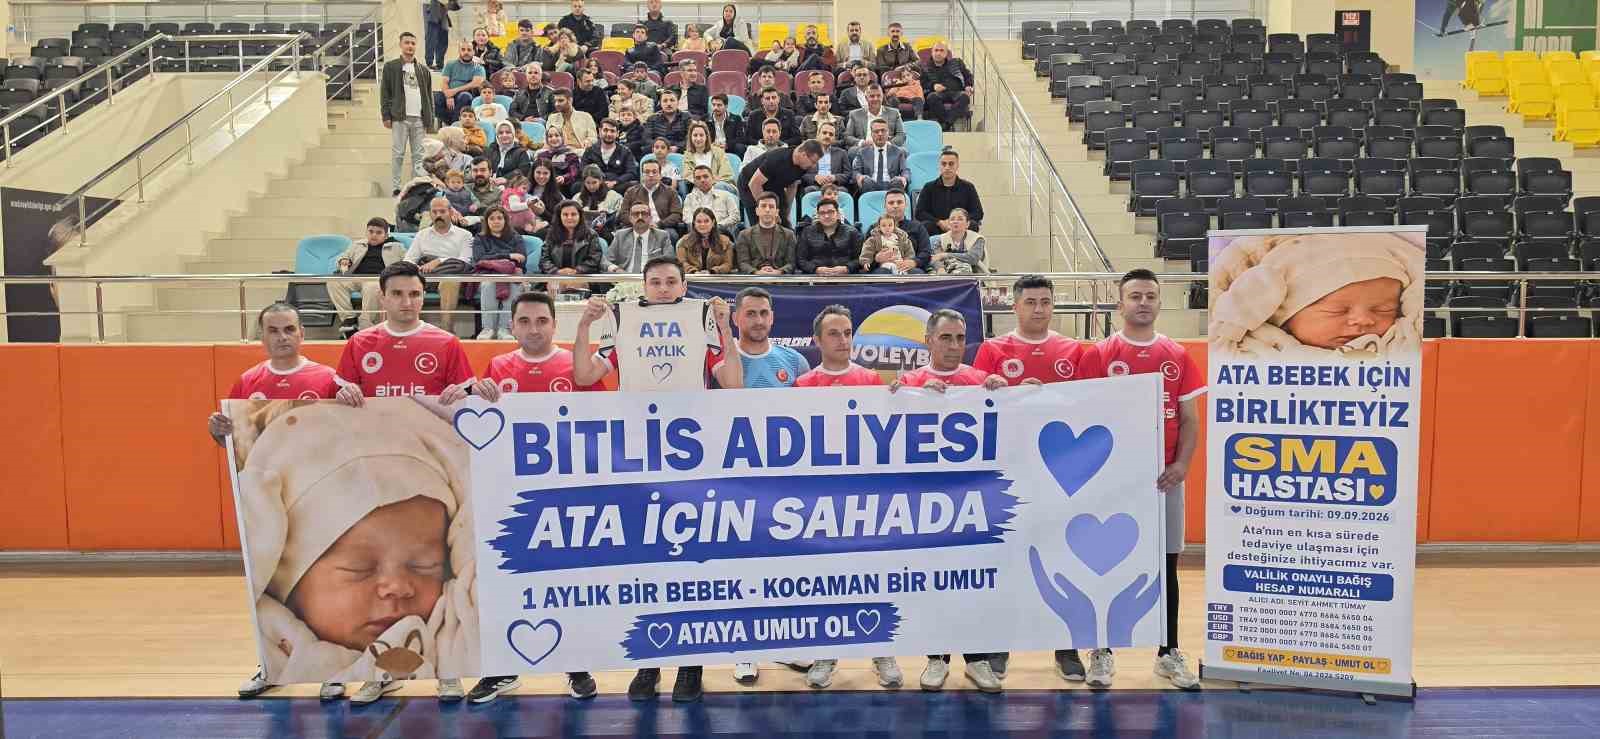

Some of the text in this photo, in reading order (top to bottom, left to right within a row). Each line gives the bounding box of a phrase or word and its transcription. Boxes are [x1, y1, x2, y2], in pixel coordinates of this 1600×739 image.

[640, 322, 682, 338] ATA
[638, 345, 686, 357] 1 AYLIK
[1216, 360, 1411, 392] ATA BEBEK İÇİN
[1216, 392, 1409, 428] BİRLİKTEYİZ
[512, 399, 999, 477] BİTLİS ADLİYESİ
[1232, 436, 1386, 476] SMA
[1231, 473, 1365, 501] HASTASI
[527, 488, 989, 556] ATA İÇİN SAHADA
[1245, 506, 1390, 521] Doğum tarihi: 09.09.2026
[1243, 525, 1380, 541] Ata'nın en kısa sürede
[1242, 540, 1379, 556] tedaviye ulaşması için
[1227, 552, 1394, 570] desteğinize ihtiyacımız var.
[522, 588, 537, 610] 1
[543, 584, 613, 609] AYLIK
[618, 577, 658, 605] BİR
[666, 579, 744, 602] BEBEK
[763, 574, 882, 600] KOCAMAN
[887, 566, 927, 594] BİR
[933, 568, 998, 592] UMUT
[1244, 568, 1372, 588] VALİLİK ONAYLI BAĞIŞ
[1256, 582, 1360, 598] HESAP NUMARALI
[677, 614, 856, 646] ATAYA UMUT OL
[1268, 654, 1284, 662] YAP
[1336, 658, 1360, 668] UMUT
[1363, 660, 1376, 670] OL
